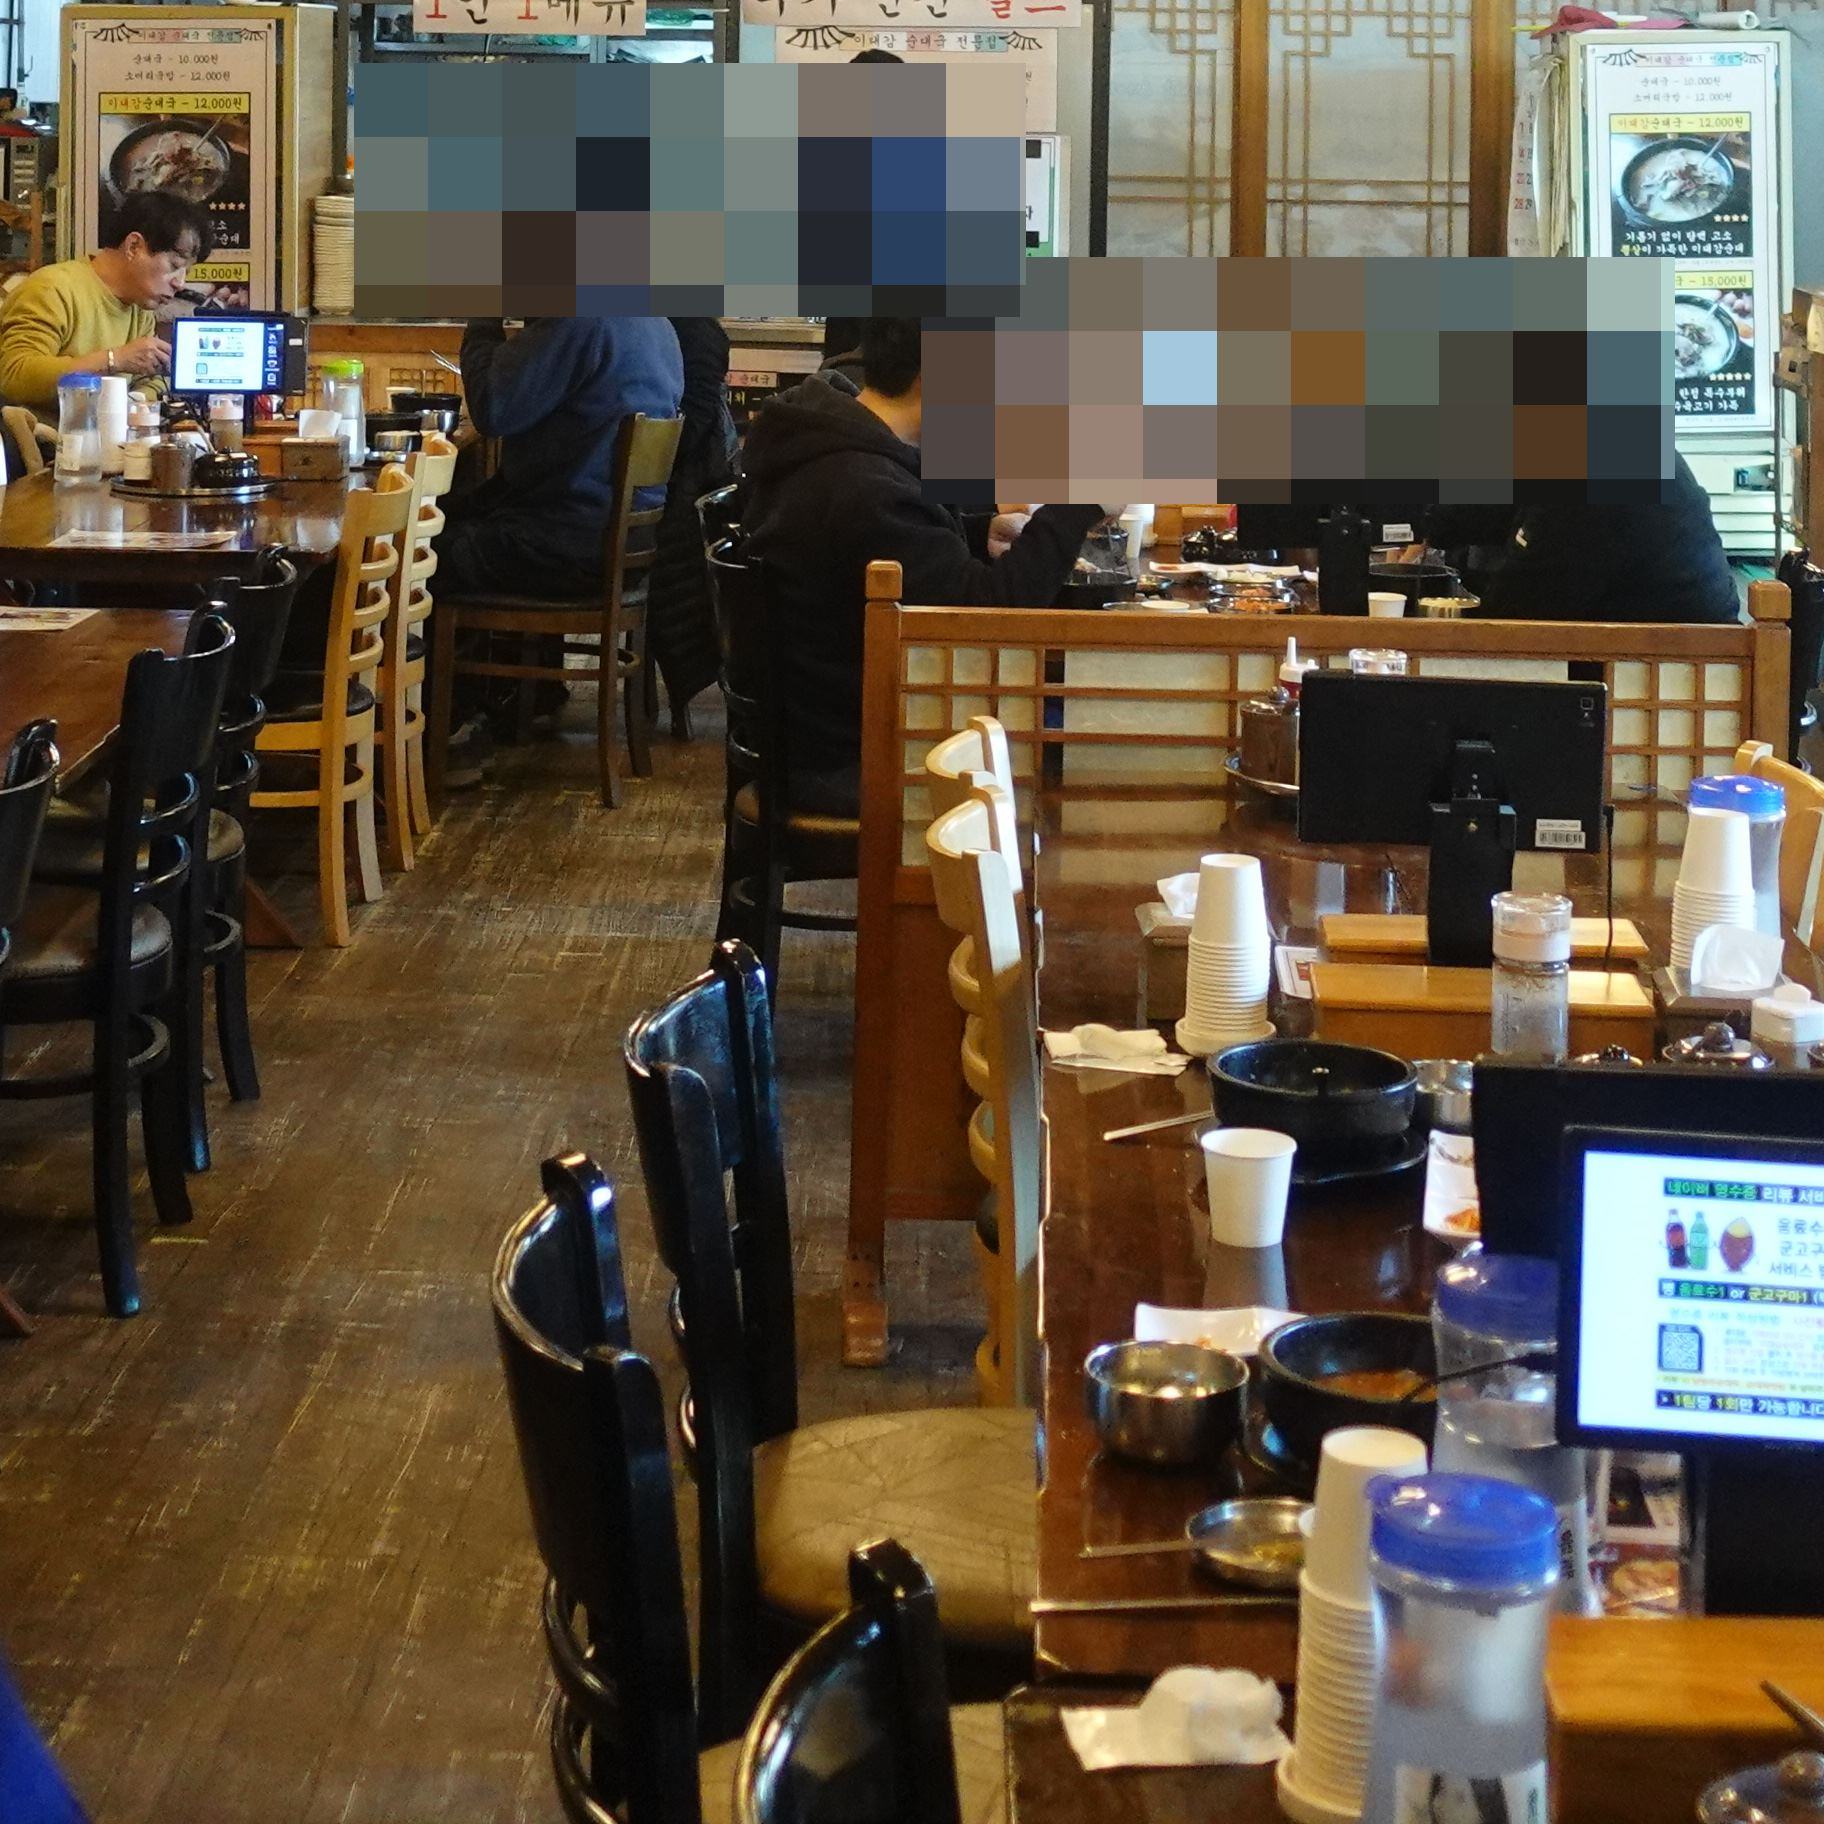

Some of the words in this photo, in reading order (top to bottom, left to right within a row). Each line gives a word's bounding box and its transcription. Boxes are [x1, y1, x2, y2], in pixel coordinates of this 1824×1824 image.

[854, 31, 897, 50] 이대감
[905, 32, 948, 51] 순대국
[956, 33, 997, 50] 전문점
[133, 54, 163, 65] 순대국
[107, 97, 177, 112] 이대감순대국
[1616, 117, 1683, 131] 이대감순대국
[1625, 230, 1658, 244] 기름기
[1661, 230, 1683, 243] 없이
[1686, 230, 1707, 244] 담백
[1711, 230, 1733, 242] 고소
[1656, 243, 1689, 257] 가득한
[1691, 242, 1744, 256] 이대감순대
[1667, 1180, 1710, 1195] 네이버
[1762, 1186, 1794, 1204] 리뷰
[1769, 1261, 1814, 1279] 서비스
[1729, 1286, 1746, 1300] or
